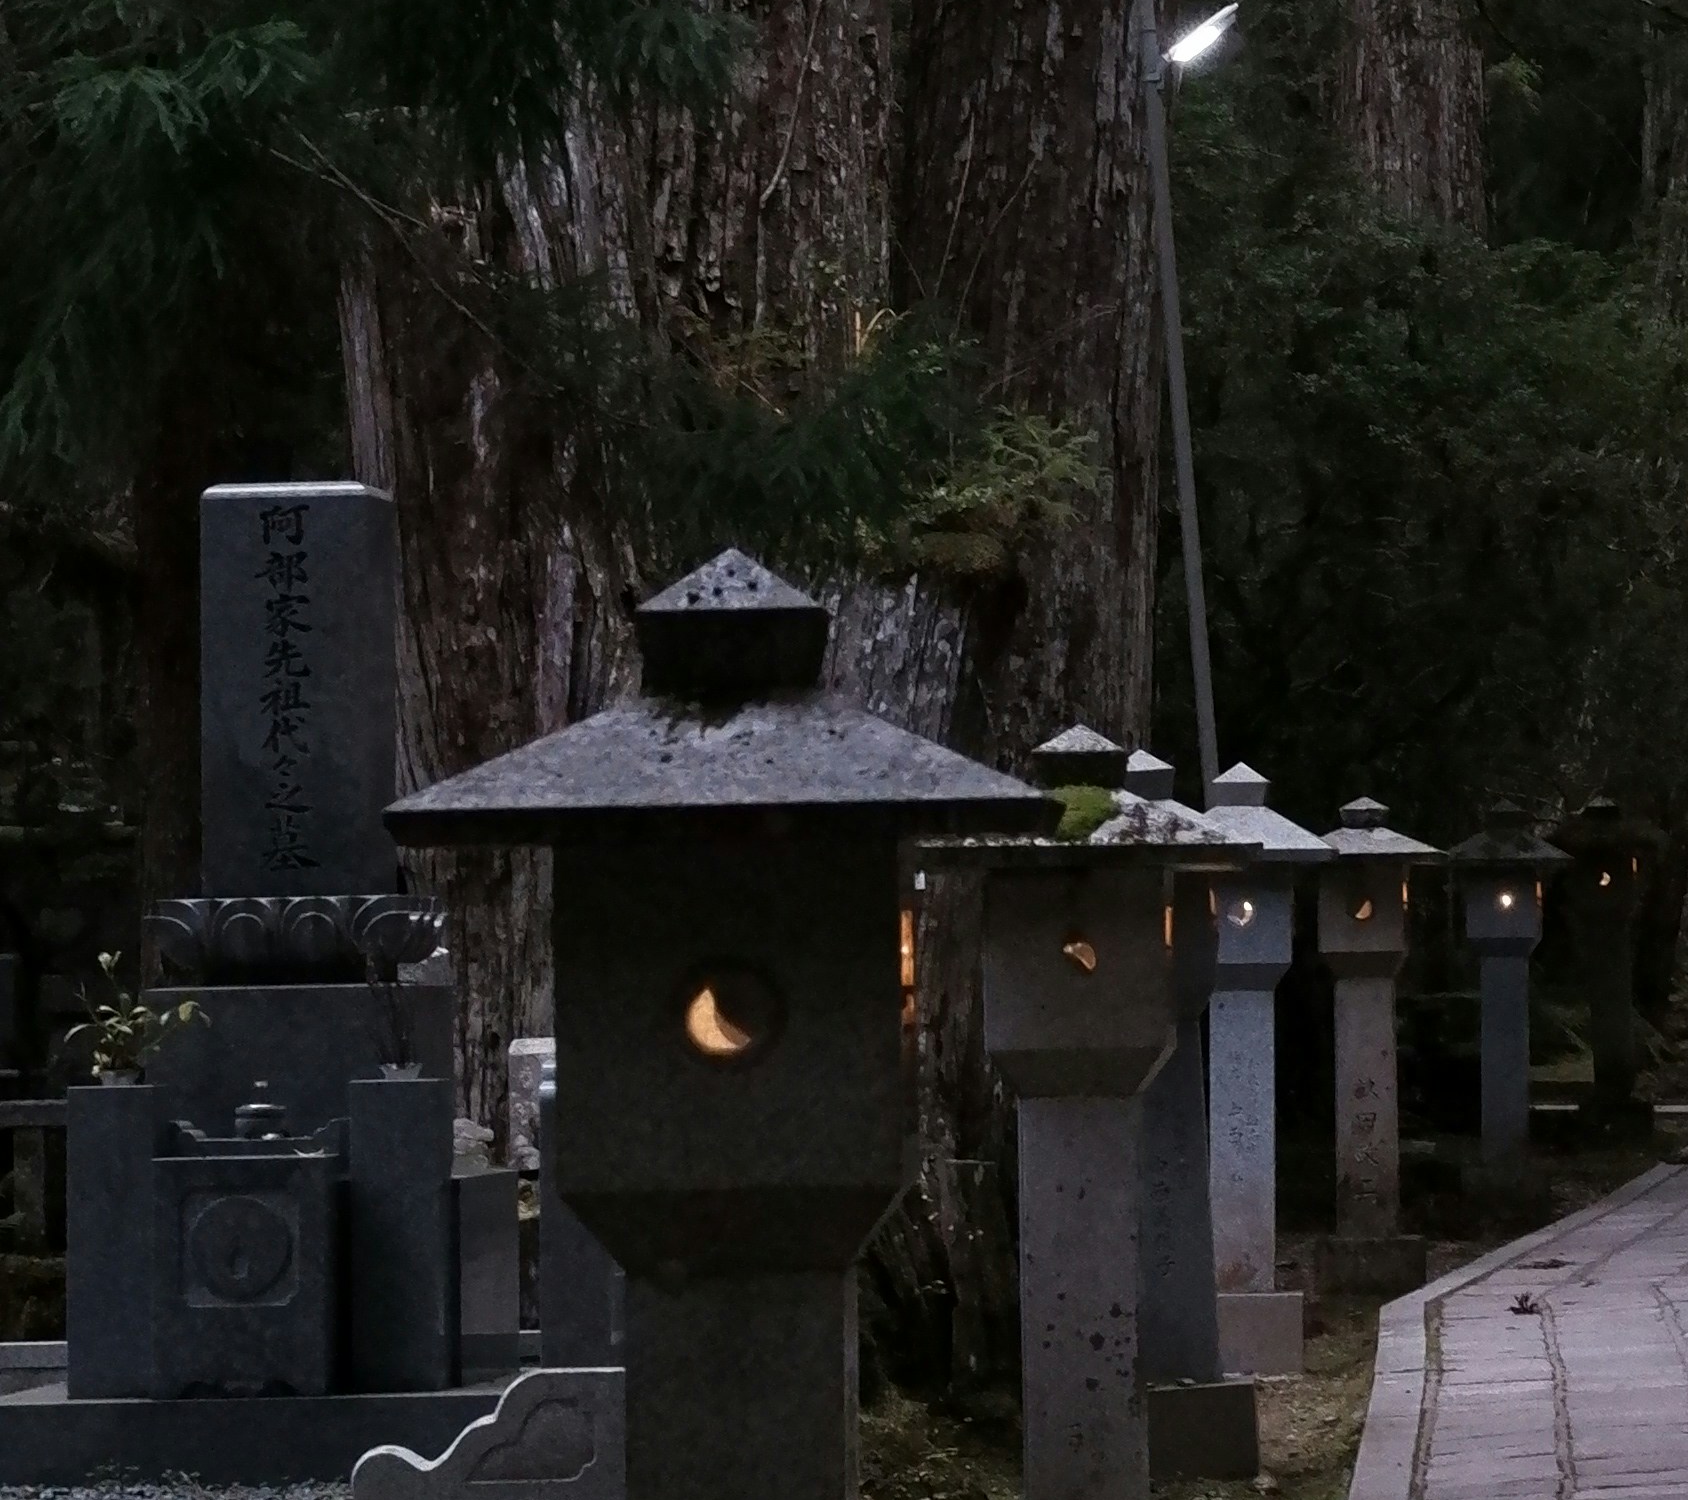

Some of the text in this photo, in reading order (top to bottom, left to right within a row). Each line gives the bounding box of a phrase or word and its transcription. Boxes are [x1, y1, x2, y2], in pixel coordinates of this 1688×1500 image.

[254, 504, 320, 872] 阿部家先祖代々之墓
